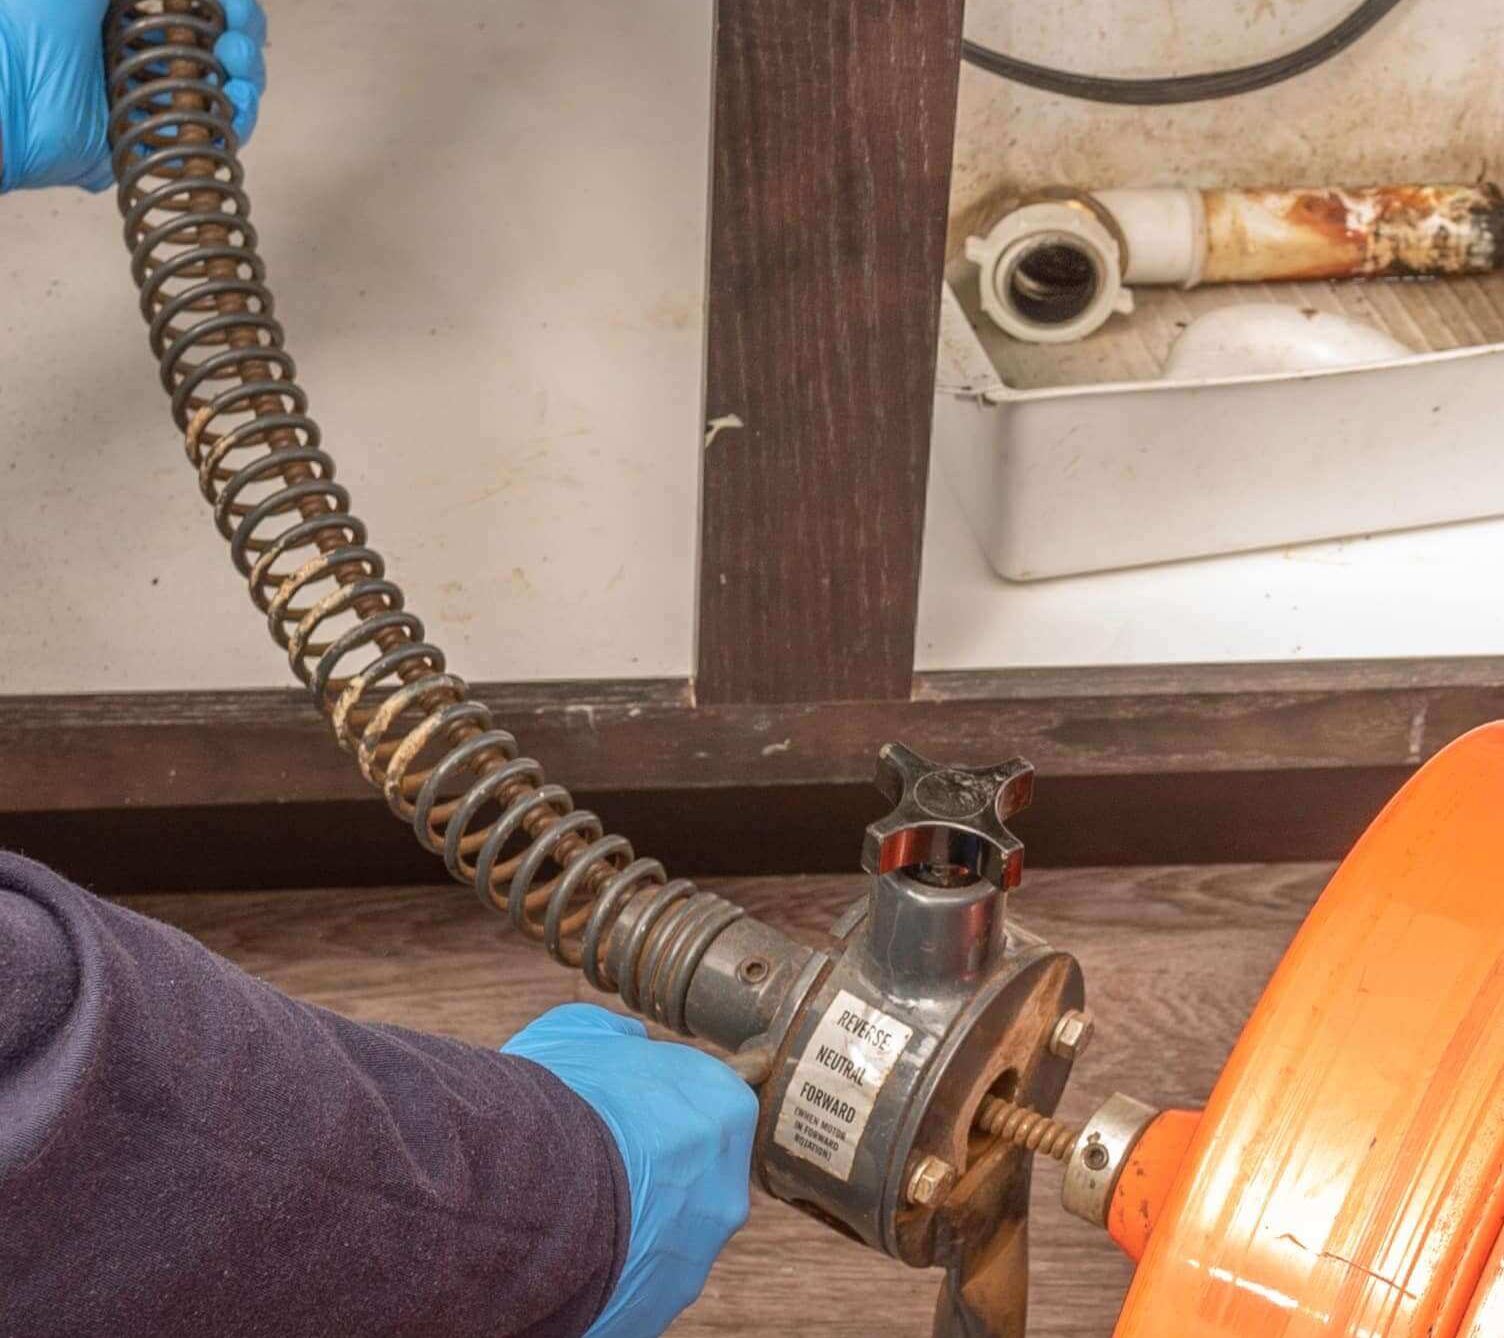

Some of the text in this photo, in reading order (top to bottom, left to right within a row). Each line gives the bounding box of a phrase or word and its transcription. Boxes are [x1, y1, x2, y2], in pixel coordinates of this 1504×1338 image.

[837, 1010, 892, 1051] REVERSE
[816, 1044, 868, 1087] NEUTRAL
[800, 1081, 857, 1124] FORWARD
